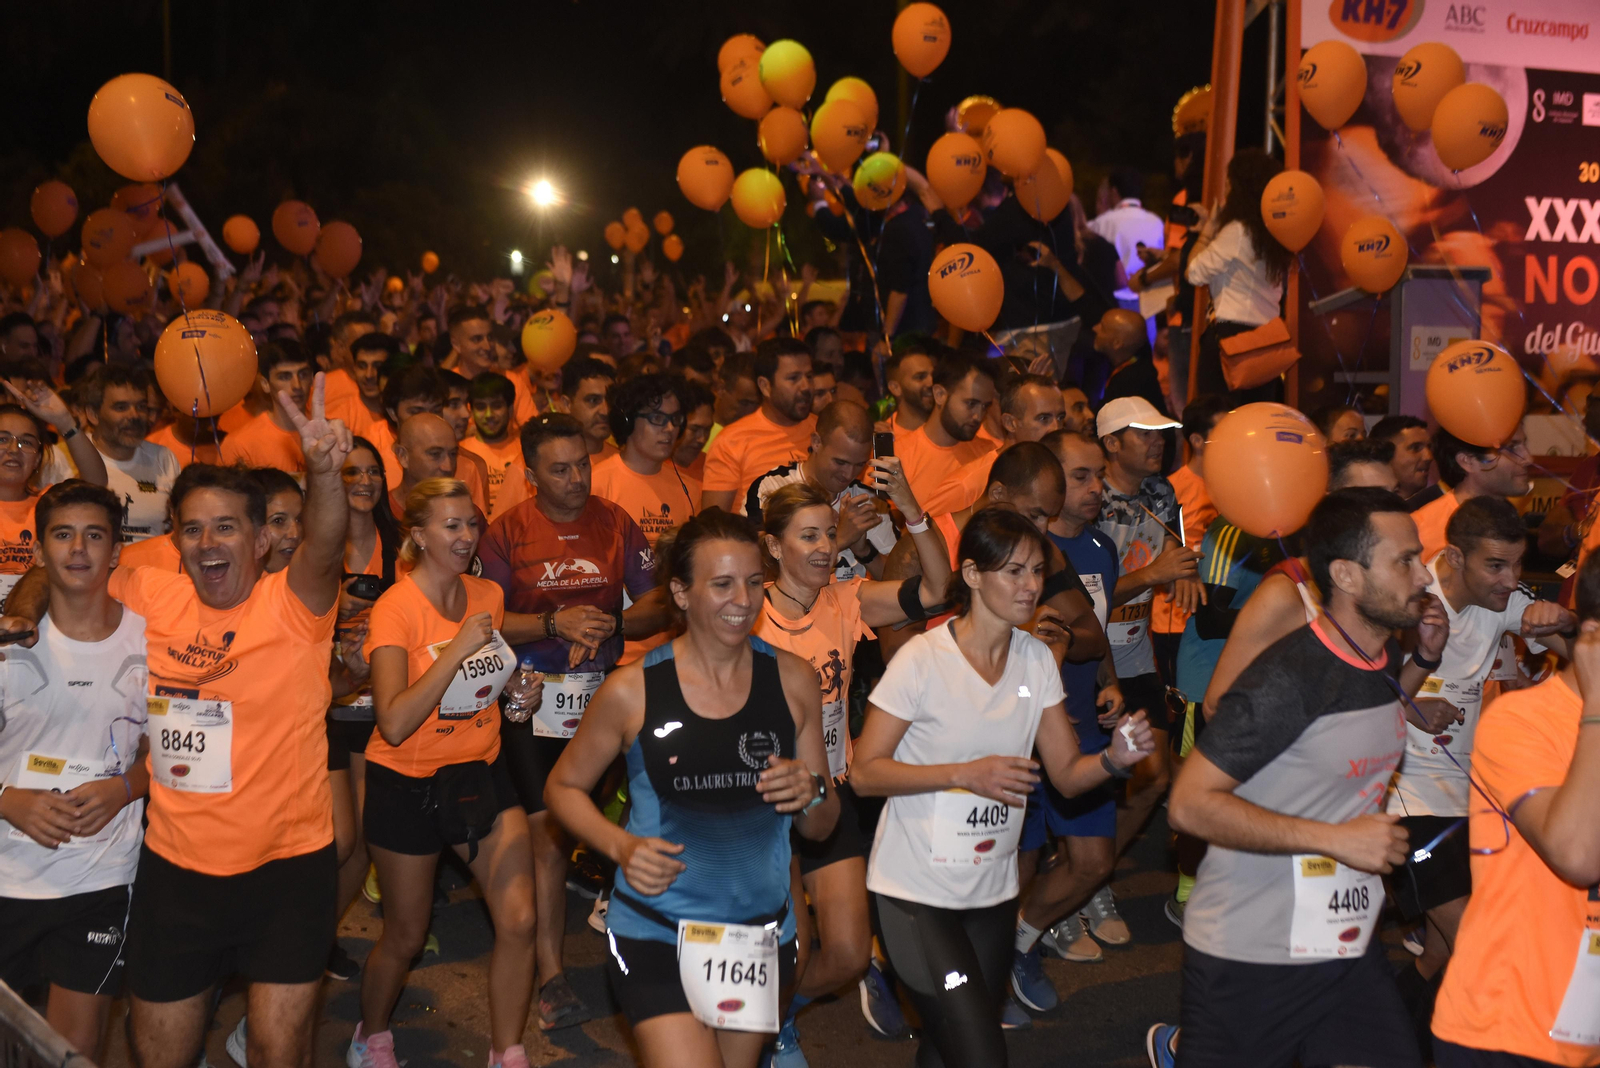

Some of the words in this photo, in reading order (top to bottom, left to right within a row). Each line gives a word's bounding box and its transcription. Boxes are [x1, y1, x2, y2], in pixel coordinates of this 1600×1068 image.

[1446, 5, 1486, 26] ABC
[1507, 12, 1591, 41] Cruzcampo
[1552, 91, 1574, 106] IMD
[940, 257, 967, 279] KH7
[1525, 254, 1600, 306] NO
[1524, 323, 1563, 356] del
[537, 580, 559, 588] MEDIA
[570, 578, 580, 586] LA
[581, 576, 609, 585] PUEBLA
[461, 654, 504, 681] 15980
[556, 692, 591, 710] 9118
[161, 729, 206, 753] 8843
[33, 757, 58, 770] Sevilla
[673, 776, 693, 791] C.D.
[694, 772, 733, 790] LAURUS
[966, 804, 1009, 828] 4409
[1328, 886, 1370, 913] 4408
[703, 958, 768, 988] 11645
